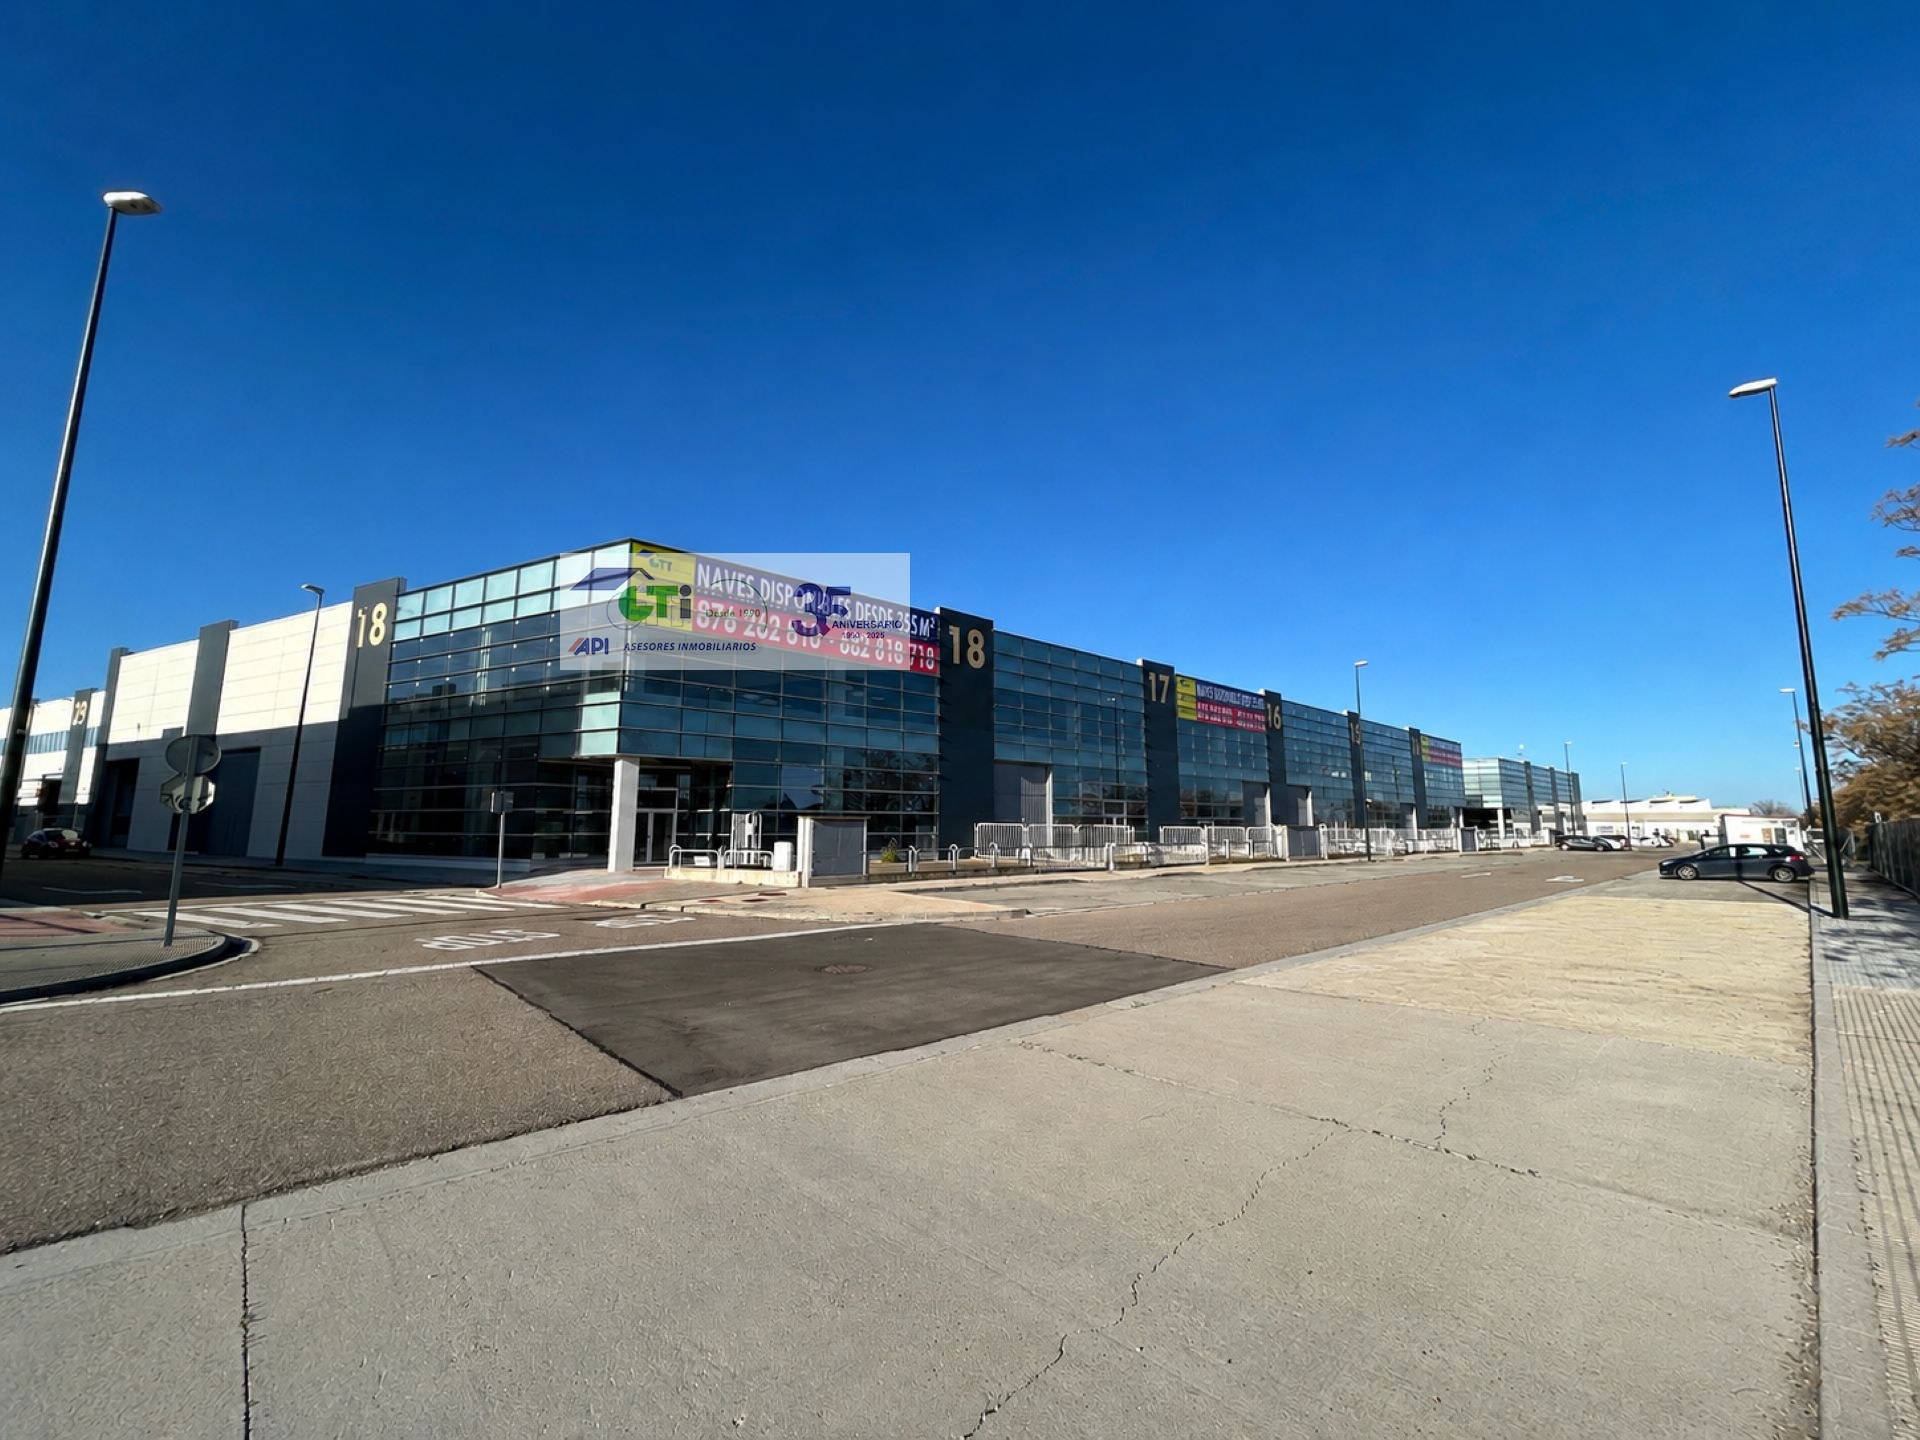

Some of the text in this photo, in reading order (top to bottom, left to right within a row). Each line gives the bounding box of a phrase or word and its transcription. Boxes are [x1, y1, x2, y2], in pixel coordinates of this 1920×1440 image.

[697, 563, 755, 599] NAVES
[855, 601, 894, 628] DESDE
[358, 602, 388, 648] 18
[696, 599, 738, 633] 876
[743, 611, 781, 642] 262
[875, 638, 904, 665] 818
[908, 643, 935, 670] 718
[949, 624, 986, 669] 18
[1148, 671, 1170, 704] 17
[1266, 703, 1282, 730] 16
